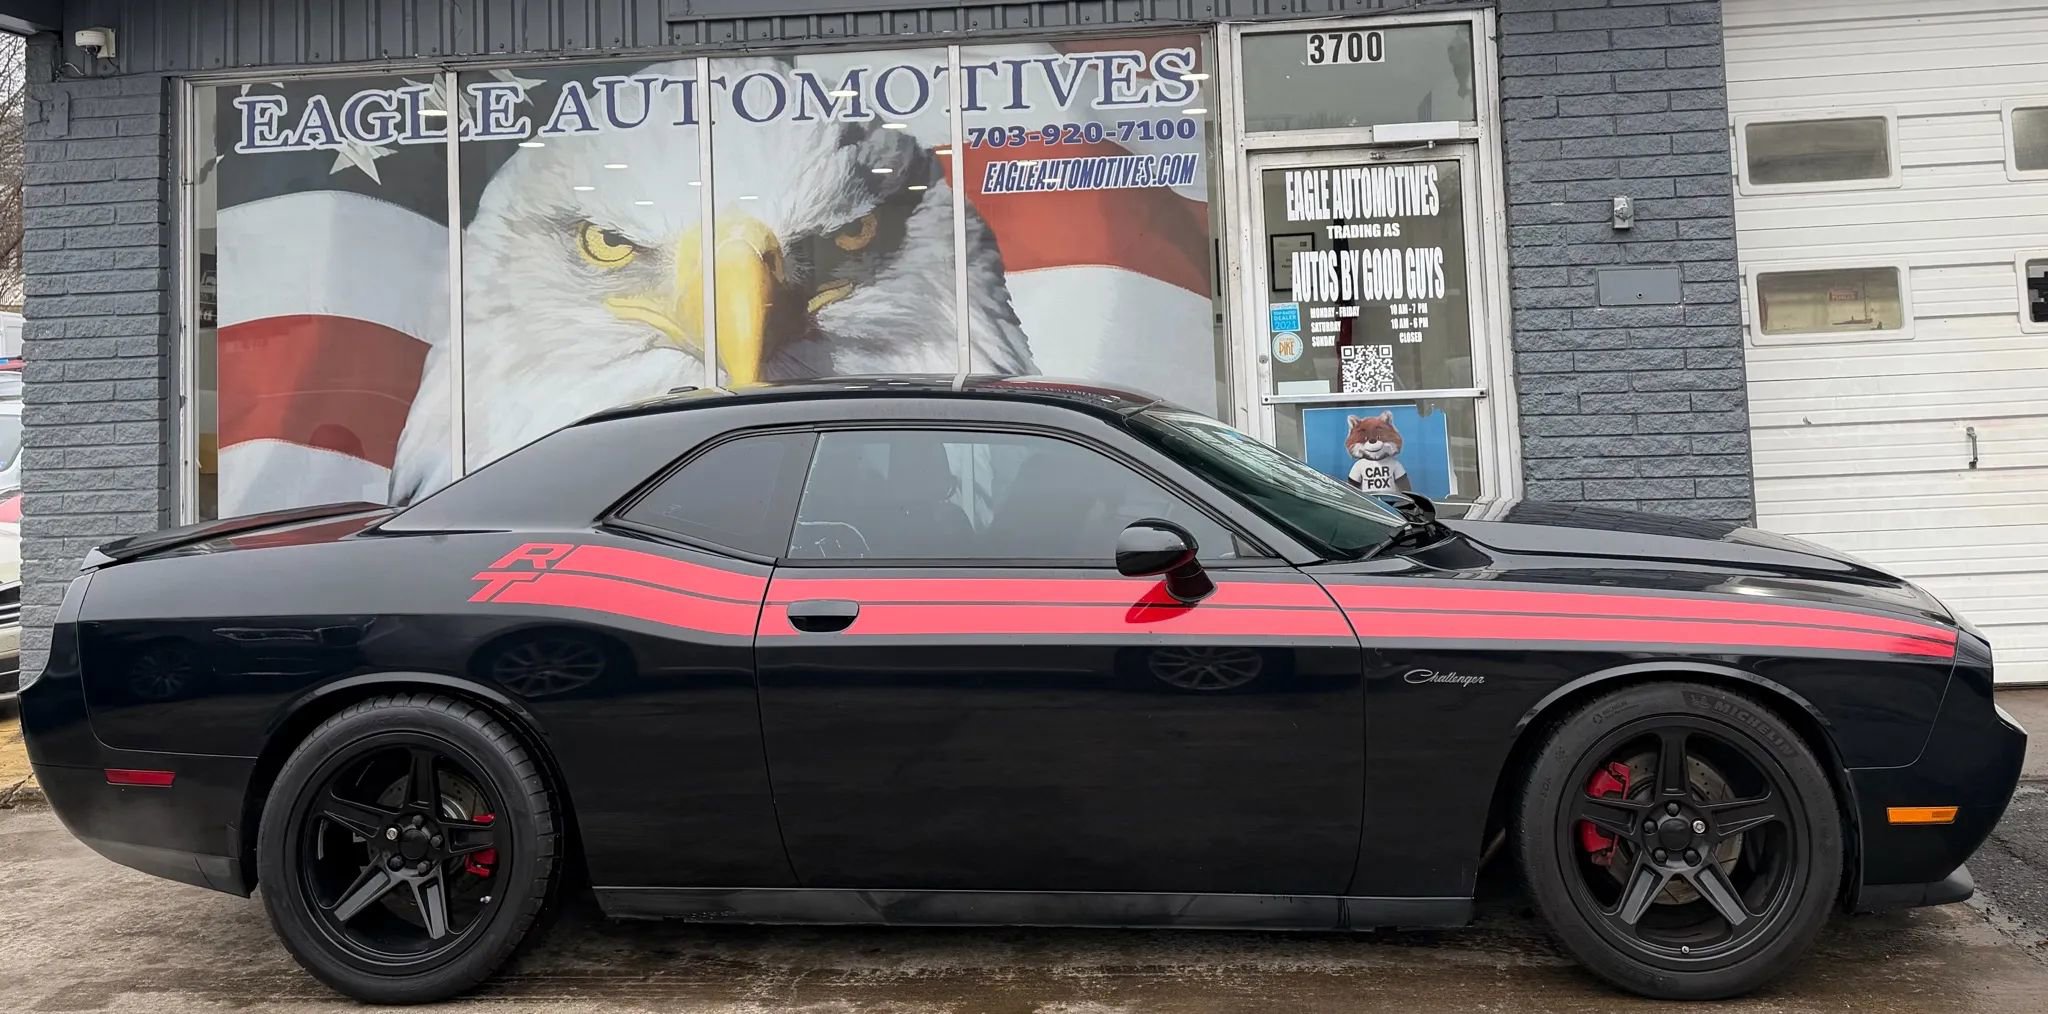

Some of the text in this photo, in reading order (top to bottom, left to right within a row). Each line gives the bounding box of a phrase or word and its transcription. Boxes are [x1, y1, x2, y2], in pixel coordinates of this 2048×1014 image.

[1309, 32, 1382, 64] 3700
[235, 48, 1197, 152] EAGLE AUTOMOTIVES
[967, 118, 1197, 148] 703-920-7100
[982, 153, 1198, 194] EAGLEAUTOMOTIVES.COM
[1285, 165, 1439, 221] EAGLE AUTOMOTIVES
[1326, 223, 1400, 239] TRADING AS
[1292, 247, 1445, 302] AUTOS BY GOOD GUYS
[1310, 307, 1335, 319] MONDAY
[1339, 305, 1360, 318] FRIDAY
[1390, 303, 1398, 315] 10
[1398, 303, 1409, 315] AM
[1417, 302, 1428, 314] PM
[1275, 320, 1297, 330] 2021
[1310, 320, 1341, 333] SATURDAY
[1391, 318, 1399, 330] 10
[1399, 317, 1410, 329] AM
[1418, 317, 1429, 328] PM
[1311, 336, 1336, 347] SUNDAY
[1399, 331, 1423, 343] CLOSED
[1365, 466, 1390, 478] CAR
[1367, 478, 1391, 489] FOX
[1404, 668, 1485, 688] Challenger
[1713, 700, 1796, 757] MICHELIN
